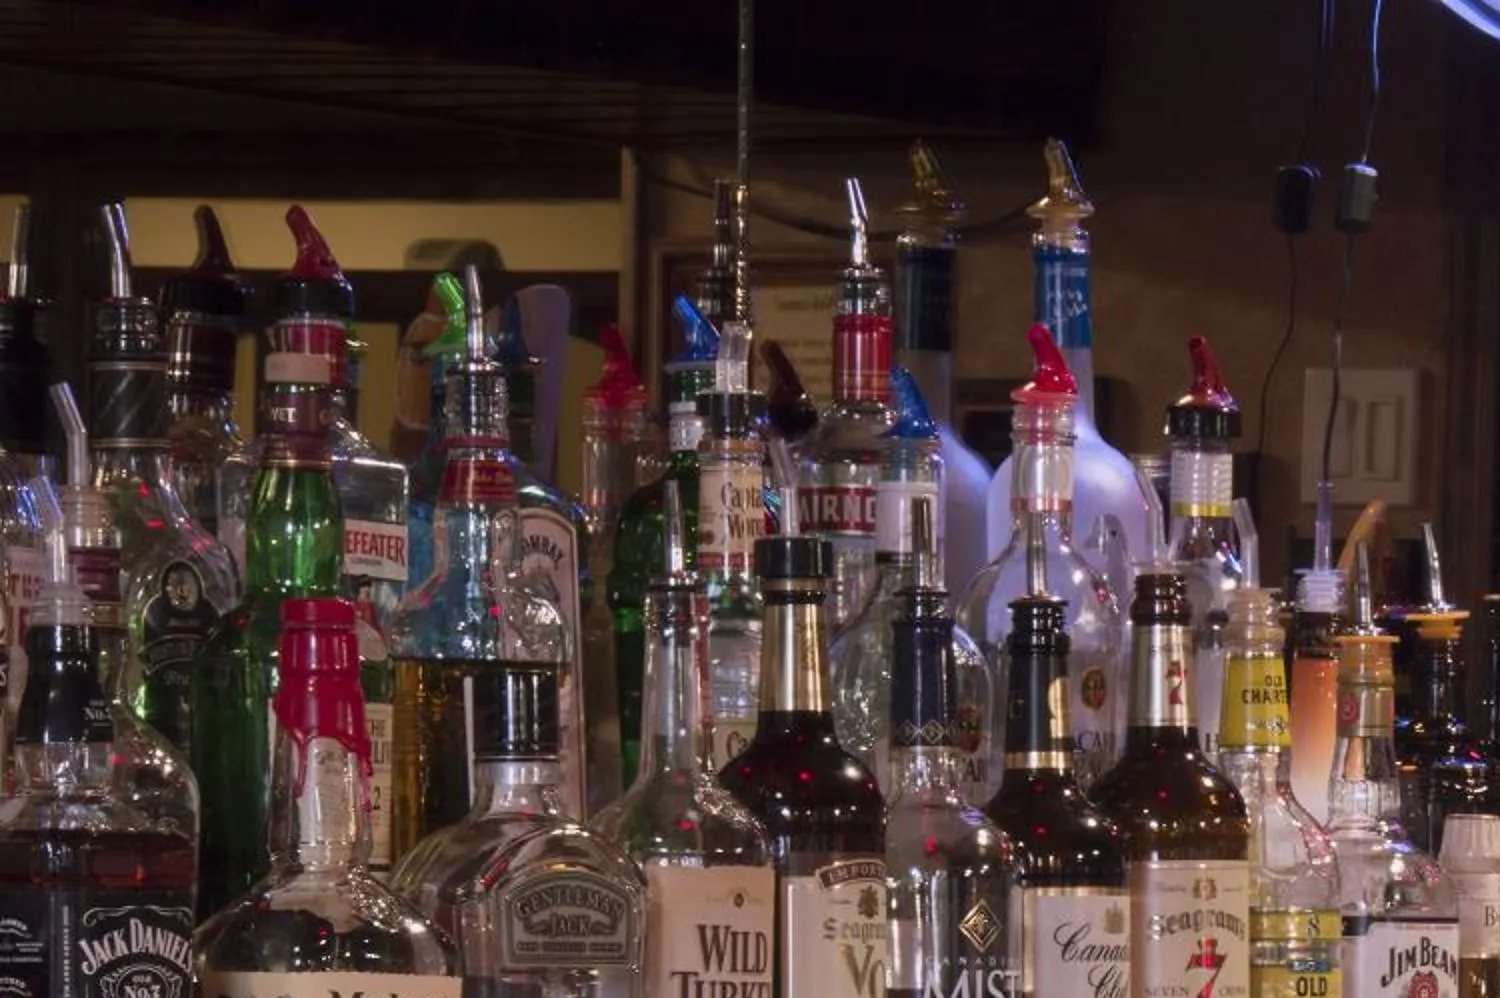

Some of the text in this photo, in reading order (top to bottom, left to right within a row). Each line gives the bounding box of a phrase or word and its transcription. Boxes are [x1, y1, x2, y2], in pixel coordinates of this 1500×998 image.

[79, 927, 131, 975] JACK
[696, 923, 769, 974] WILD
[1380, 946, 1418, 989] JIM
[1296, 976, 1328, 997] OLD
